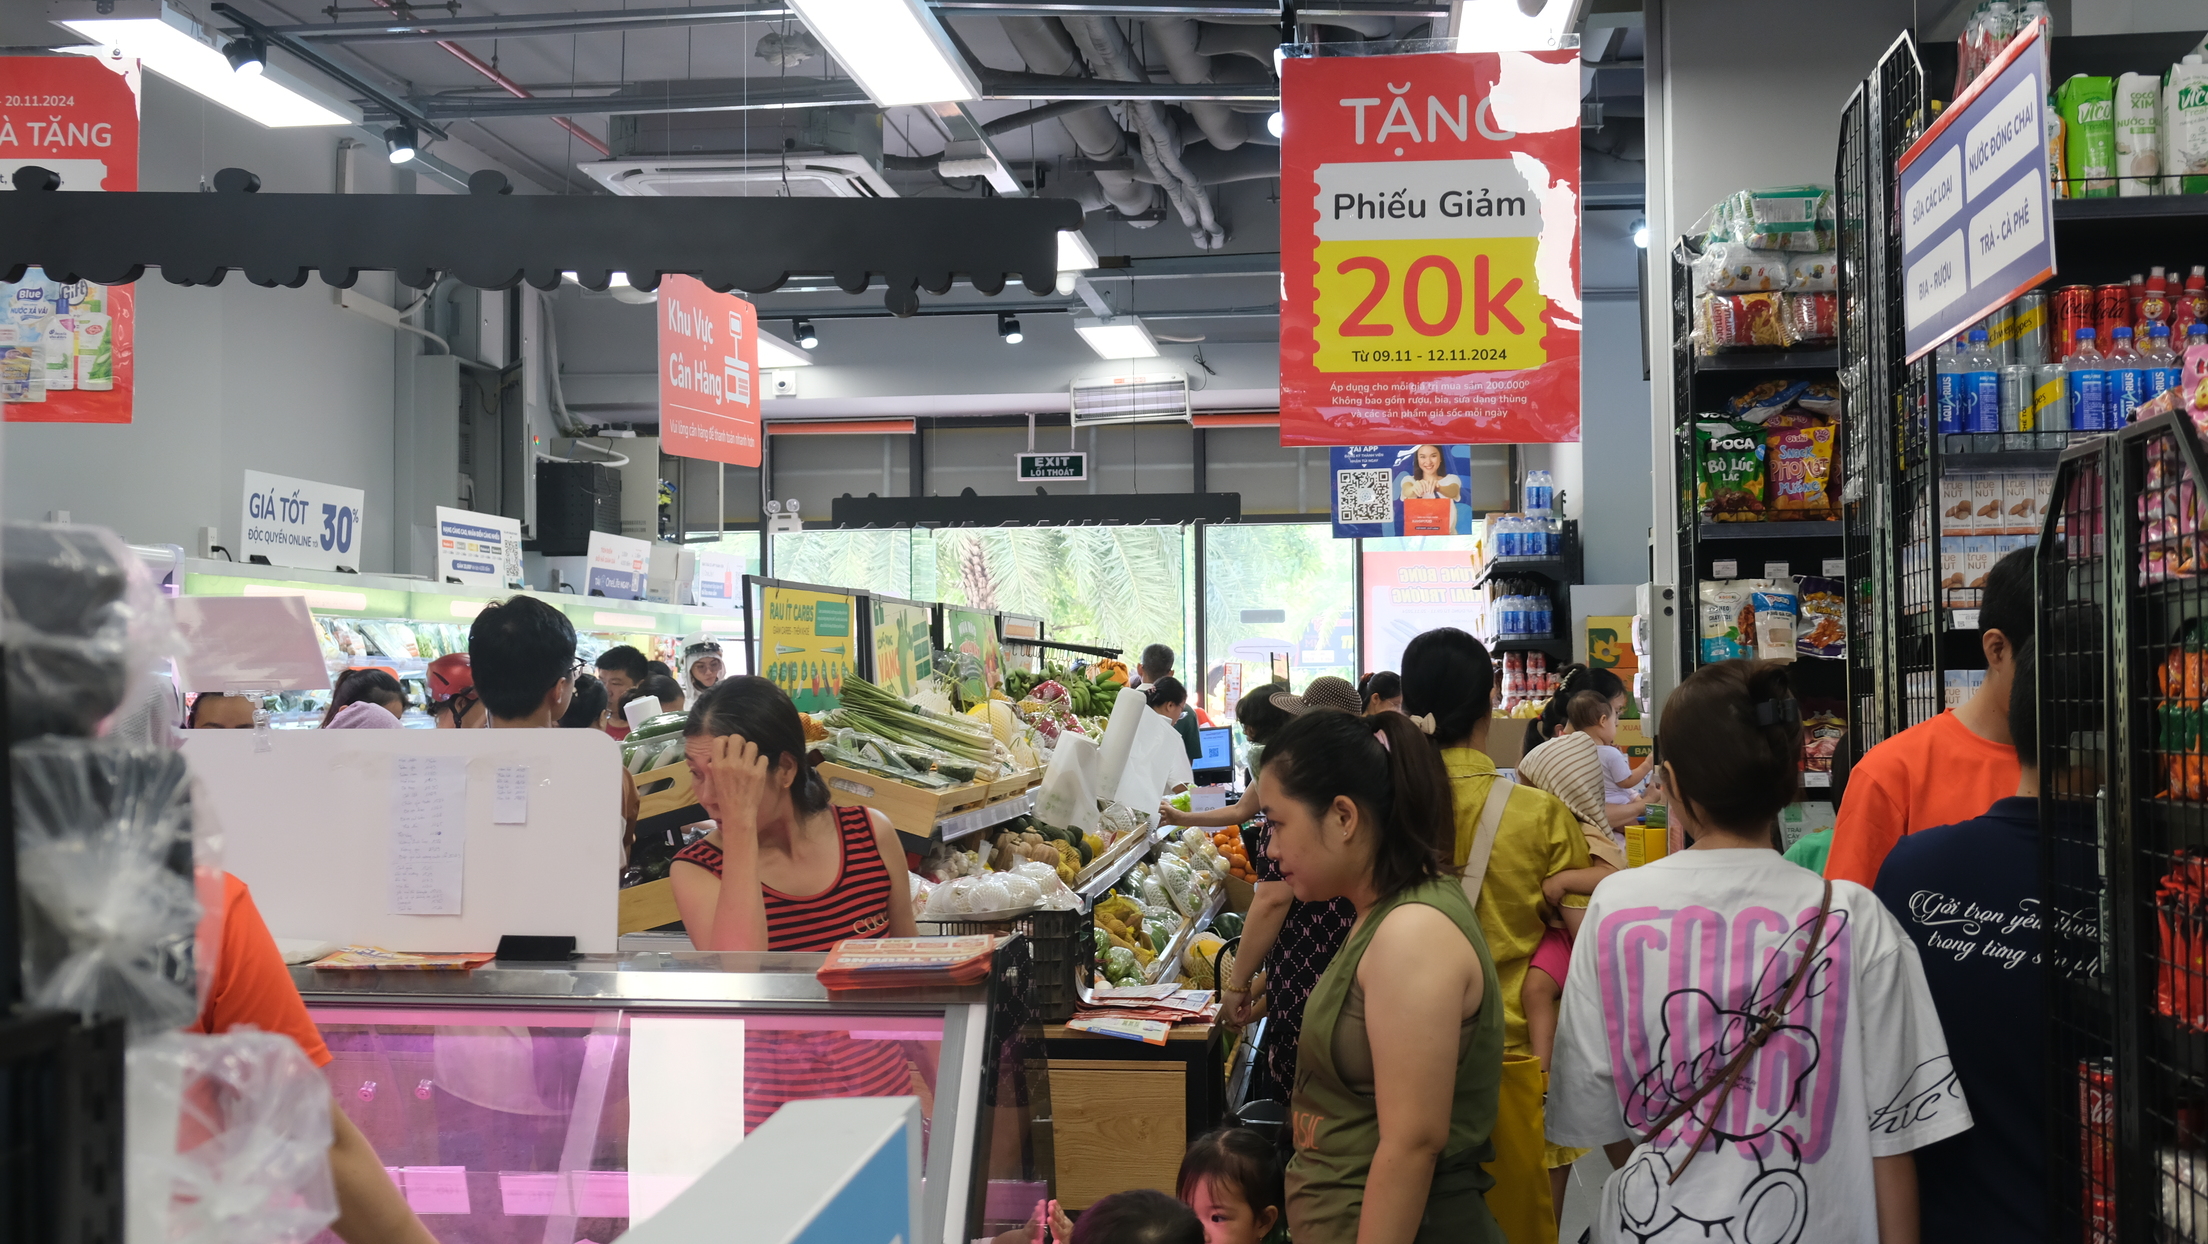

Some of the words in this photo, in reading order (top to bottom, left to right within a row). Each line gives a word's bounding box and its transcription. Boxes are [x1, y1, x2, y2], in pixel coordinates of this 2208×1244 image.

[5, 95, 75, 107] 20.11.2024
[2131, 99, 2154, 109] XIM
[26, 115, 112, 153] TẶNG
[1968, 139, 1990, 176] NƯỚC
[1990, 125, 2013, 157] ĐÓNG
[2013, 101, 2034, 136] CHAI
[1333, 188, 1426, 220] Phiếu
[1439, 188, 1526, 218] Giảm
[1912, 202, 1925, 226] SỮA
[1925, 185, 1938, 214] CÁC
[1938, 174, 1953, 201] LOẠI
[1979, 224, 1996, 257] TRÀ
[2001, 211, 2013, 242] CÀ
[2013, 197, 2030, 232] PHÊ
[19, 289, 42, 299] Blue
[1337, 254, 1525, 337] 20k
[1918, 281, 1930, 301] BIA
[668, 296, 692, 338] Khu
[693, 306, 714, 351] Vực
[1352, 349, 1370, 362] Từ
[1372, 350, 1412, 362] 09.11
[1427, 349, 1508, 362] 12.11.2024
[669, 352, 692, 390] Cân
[694, 359, 722, 405] Hàng
[1329, 381, 1344, 392] Áp
[1348, 382, 1370, 393] dụng
[1372, 382, 1389, 391] cho
[1441, 383, 1461, 391] mua
[1331, 395, 1363, 406] Không
[1364, 395, 1382, 405] bao
[1384, 394, 1406, 406] gồm
[1434, 395, 1451, 405] bia,
[1473, 394, 1497, 406] dạng
[1499, 394, 1528, 405] thùng
[1942, 376, 1953, 422] AQUARIUS
[1351, 409, 1363, 418] và
[1364, 408, 1380, 418] các
[1429, 408, 1444, 419] giá
[1446, 407, 1463, 417] sốc
[1485, 408, 1508, 419] ngày
[1710, 438, 1756, 451] POCA
[1035, 457, 1070, 467] EXIT
[1707, 457, 1727, 474] BÒ
[1731, 455, 1754, 473] LÚC
[1047, 468, 1075, 477] THOÁT
[1943, 481, 1964, 490] true
[1975, 480, 1995, 489] true
[2006, 480, 2026, 488] true
[2037, 479, 2052, 487] tru
[1943, 490, 1963, 498] NUT
[1975, 489, 1995, 497] NUT
[2006, 488, 2026, 496] NUT
[249, 487, 276, 521] GIÁ
[279, 488, 309, 525] TỐT
[248, 526, 264, 543] ĐỘC
[288, 533, 311, 548] ONLINE
[1967, 553, 1988, 562] true
[770, 602, 785, 621] RAU
[793, 604, 814, 622] CARBS
[1963, 902, 2006, 925] trọn
[1927, 930, 1978, 962] trong
[1981, 939, 2027, 970] từng
